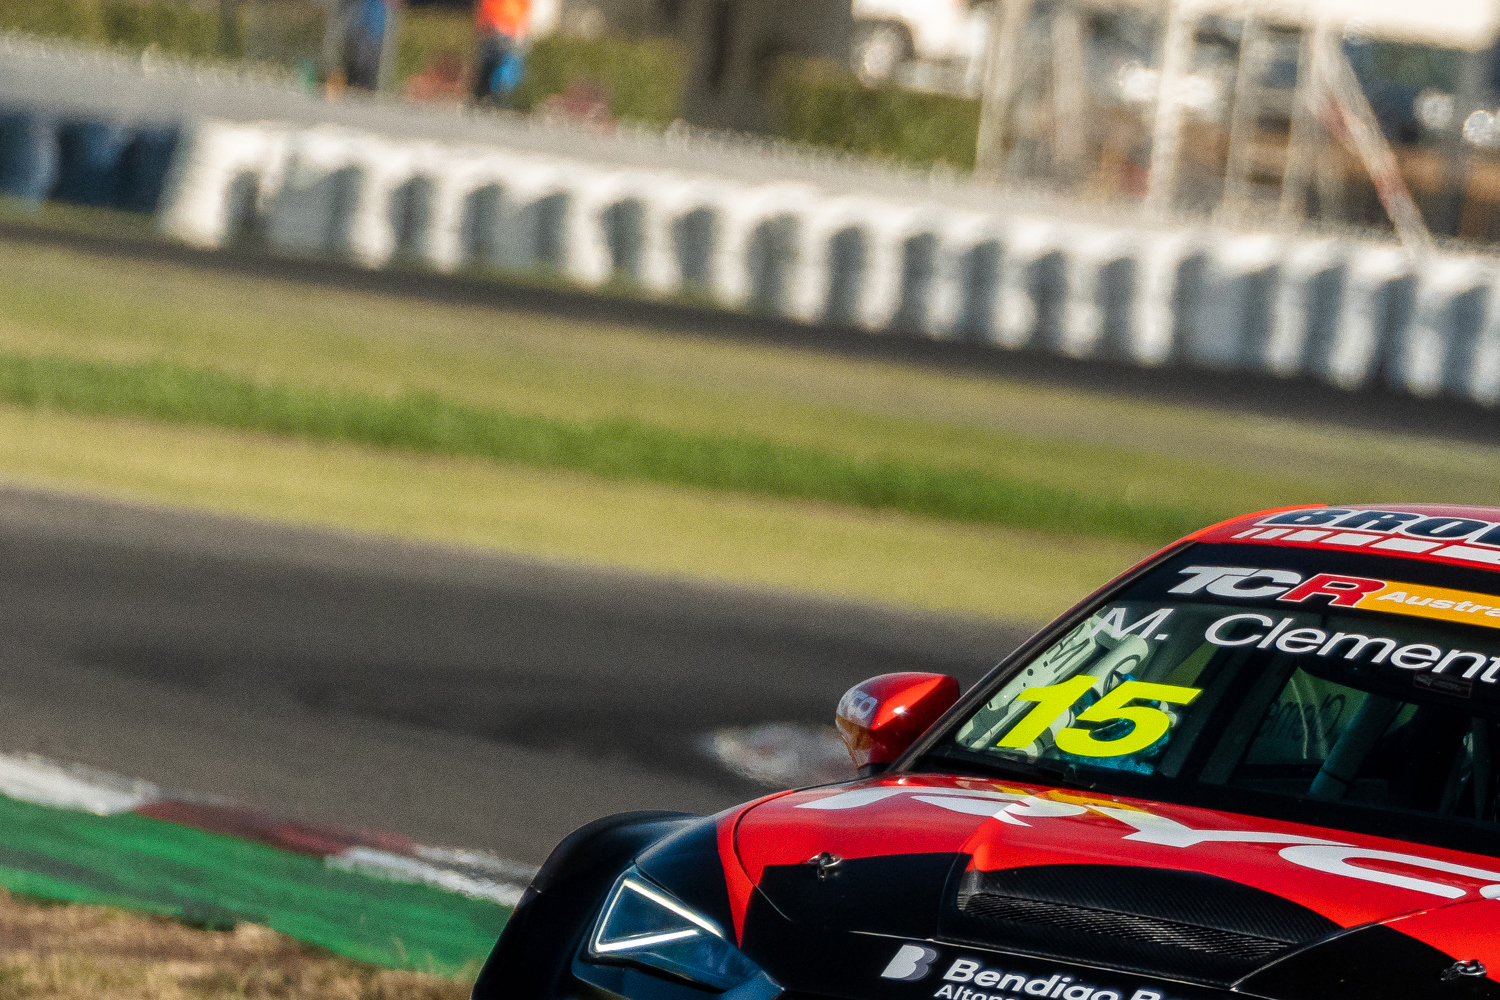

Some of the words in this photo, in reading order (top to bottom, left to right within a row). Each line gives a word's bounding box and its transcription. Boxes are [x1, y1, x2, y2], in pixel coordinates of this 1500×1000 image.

[1167, 565, 1387, 608] TCR
[1090, 607, 1174, 640] M.
[996, 675, 1203, 758] 15
